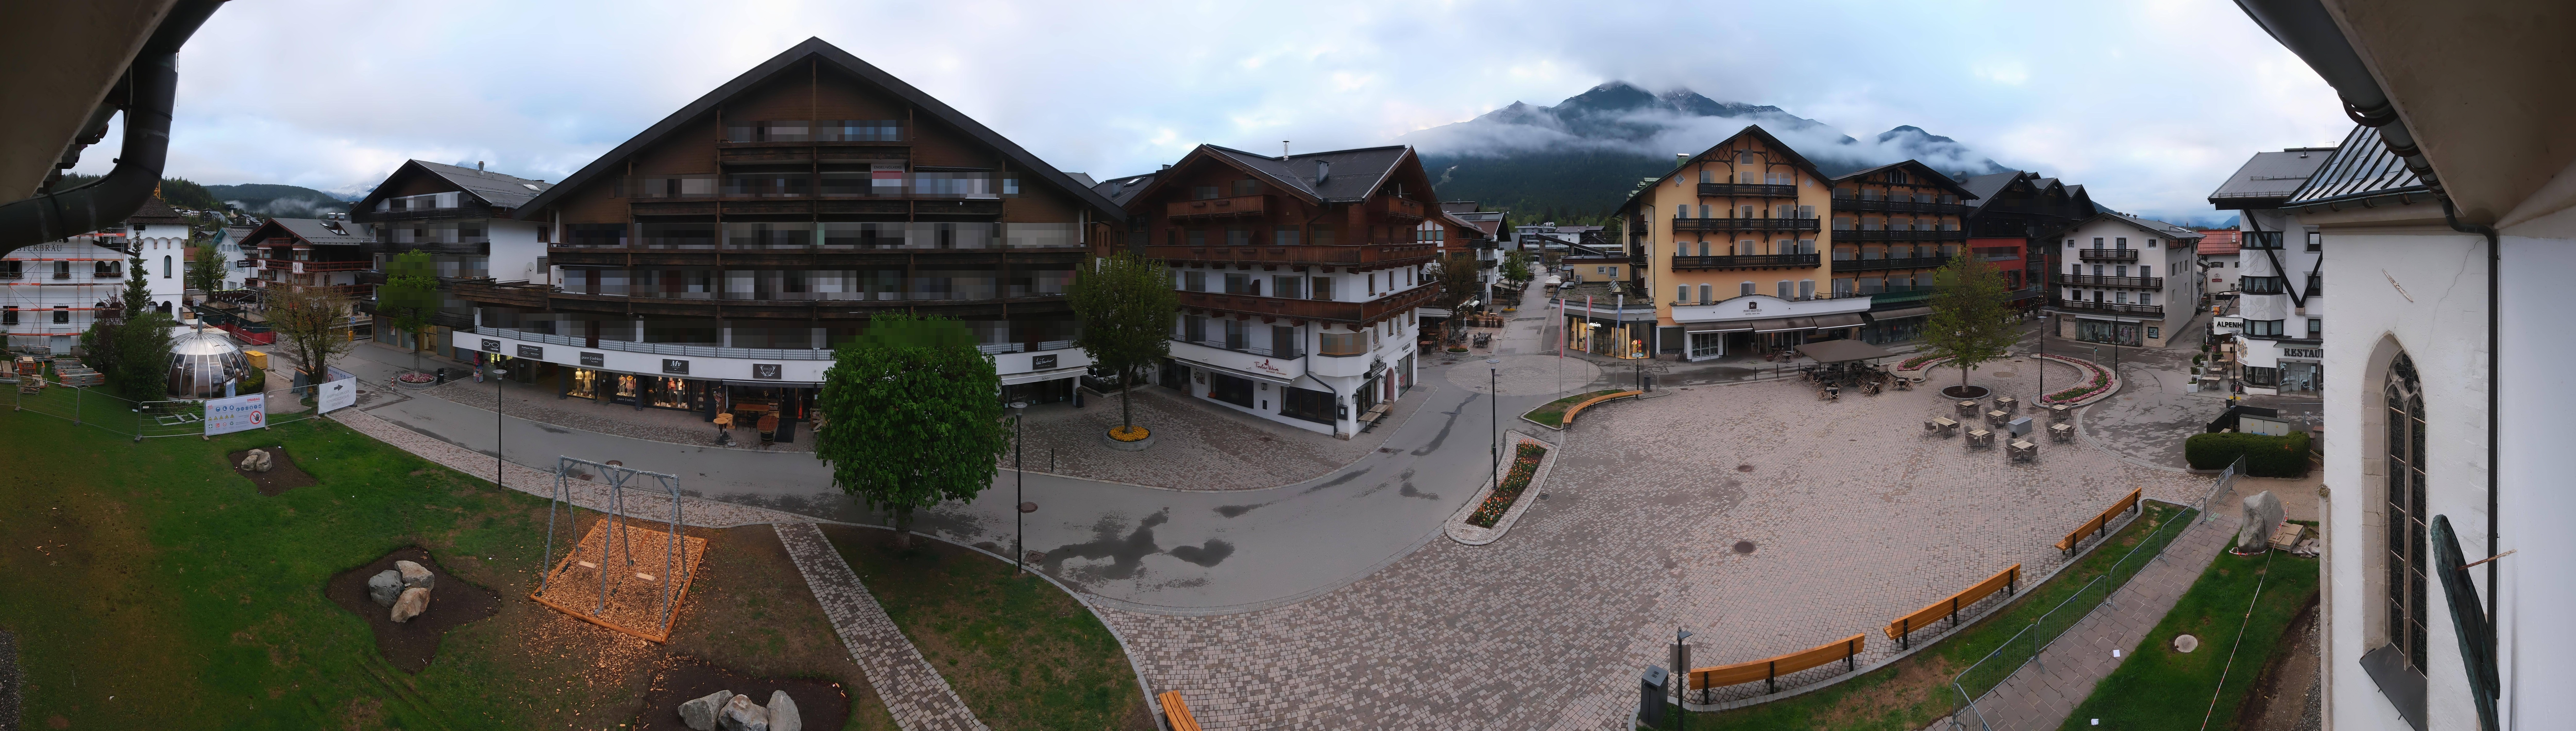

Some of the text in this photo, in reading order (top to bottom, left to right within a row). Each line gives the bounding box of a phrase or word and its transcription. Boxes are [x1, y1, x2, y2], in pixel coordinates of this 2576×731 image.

[1402, 343, 1411, 352] SAILER
[2284, 348, 2323, 358] RESTAU
[1371, 364, 1386, 377] RESTAURANT
[326, 395, 349, 403] KONGRESSZENTRUM
